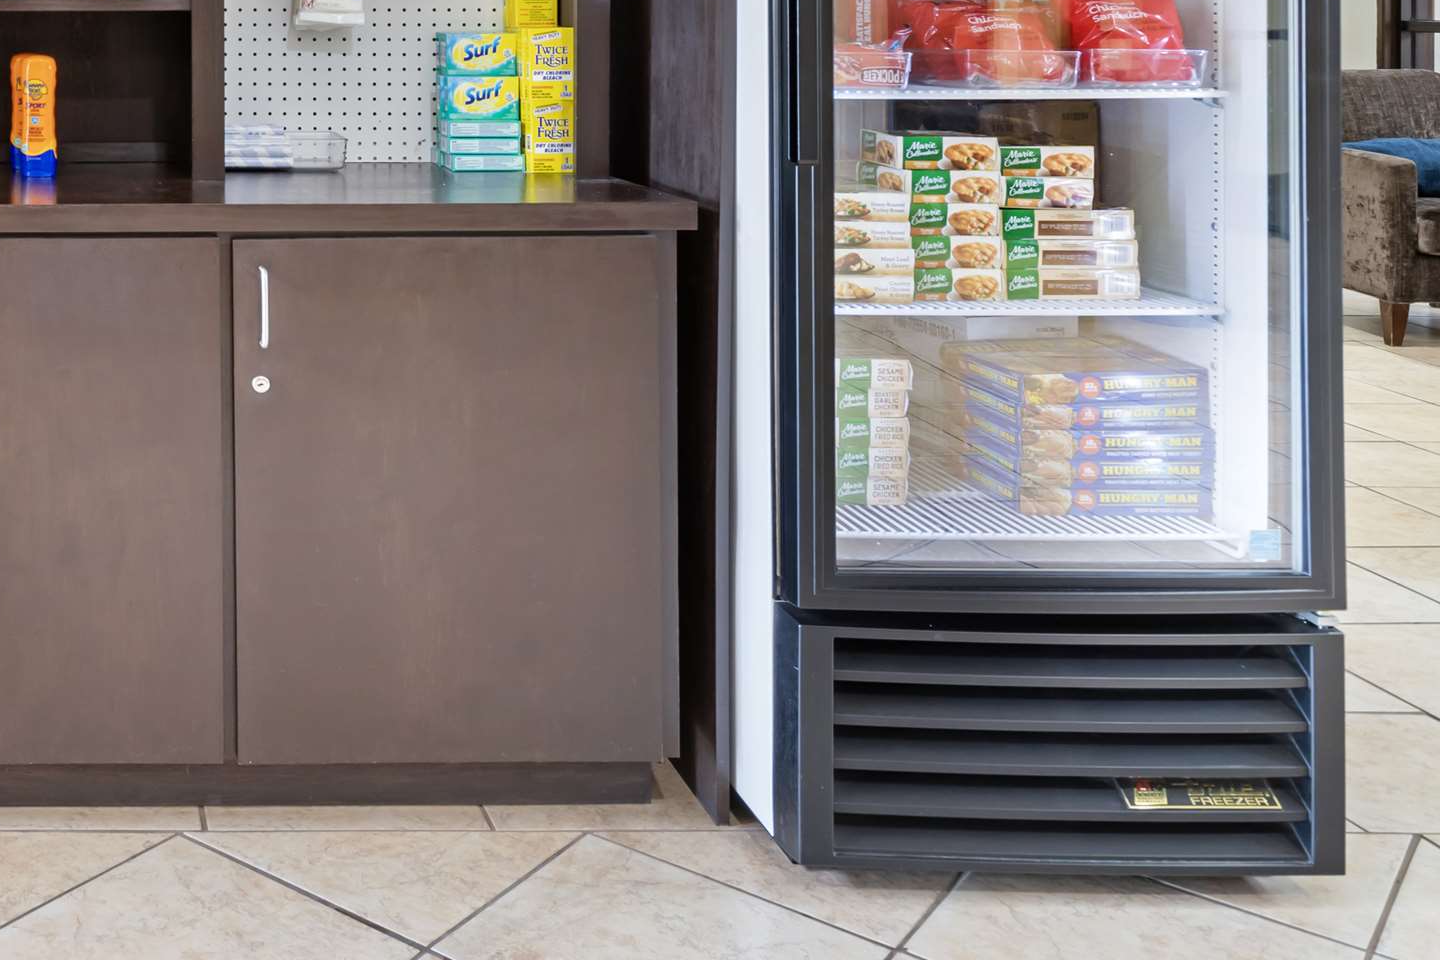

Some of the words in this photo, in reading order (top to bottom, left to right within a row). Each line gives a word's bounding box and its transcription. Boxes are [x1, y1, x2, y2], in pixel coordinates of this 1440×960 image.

[463, 36, 501, 61] Surf
[534, 43, 569, 55] TWICE
[535, 54, 569, 67] FRESH
[464, 80, 504, 105] Surf
[536, 116, 569, 127] TWICE
[537, 127, 570, 140] FRESH
[1189, 796, 1269, 806] FREEZER
